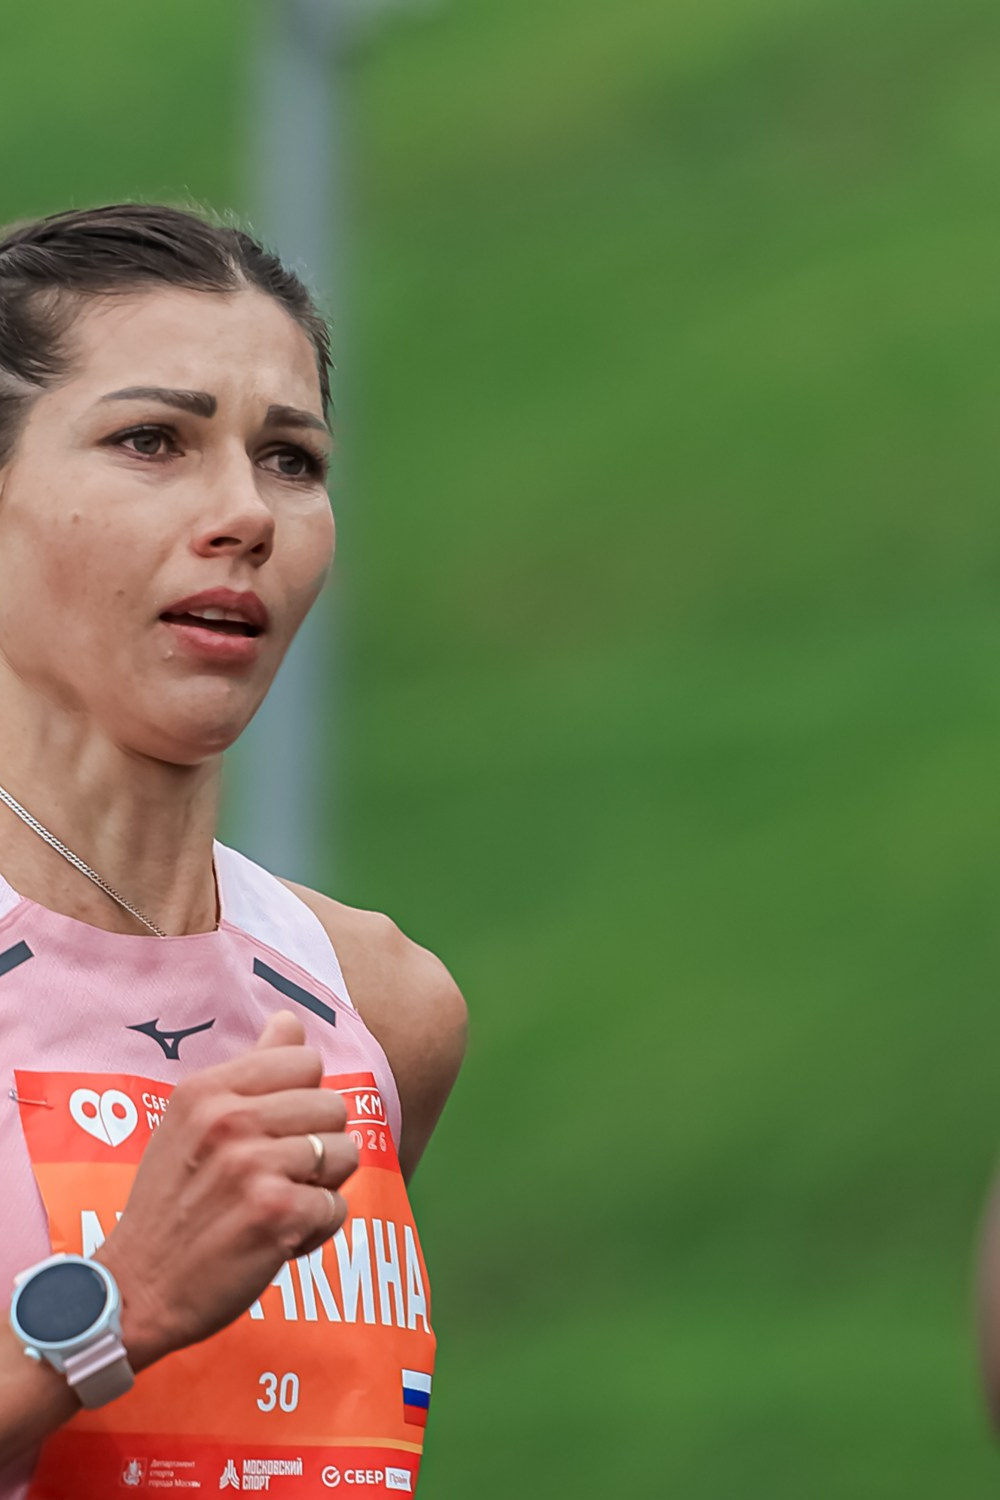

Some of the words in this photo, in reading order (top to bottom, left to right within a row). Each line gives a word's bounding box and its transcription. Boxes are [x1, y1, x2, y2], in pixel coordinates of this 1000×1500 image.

[142, 1092, 169, 1112] СБЕ
[257, 1372, 299, 1413] 30
[243, 1457, 303, 1476] МОСКОВСКИЙ
[242, 1475, 271, 1491] СПОРТ
[344, 1469, 384, 1484] СБЕР
